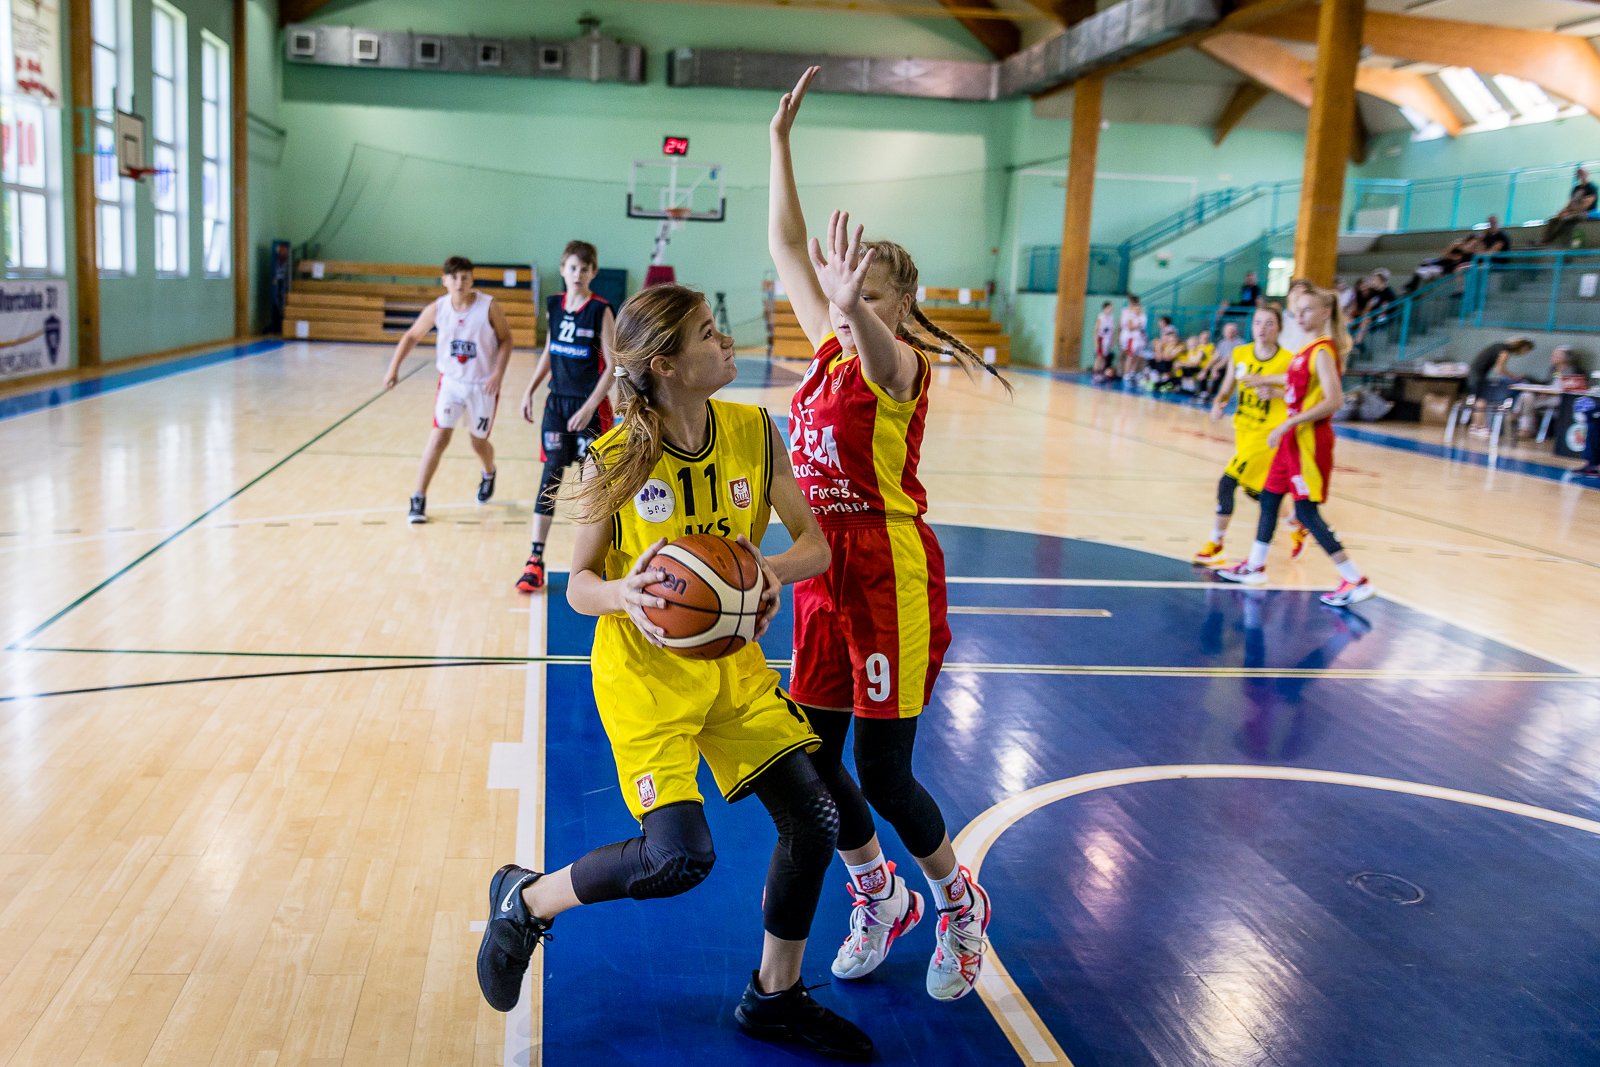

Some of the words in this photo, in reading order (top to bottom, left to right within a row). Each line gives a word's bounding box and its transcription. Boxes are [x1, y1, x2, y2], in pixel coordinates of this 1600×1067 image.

[664, 138, 688, 154] 24
[558, 320, 576, 343] 22
[677, 463, 718, 516] 11
[866, 653, 891, 702] 9
